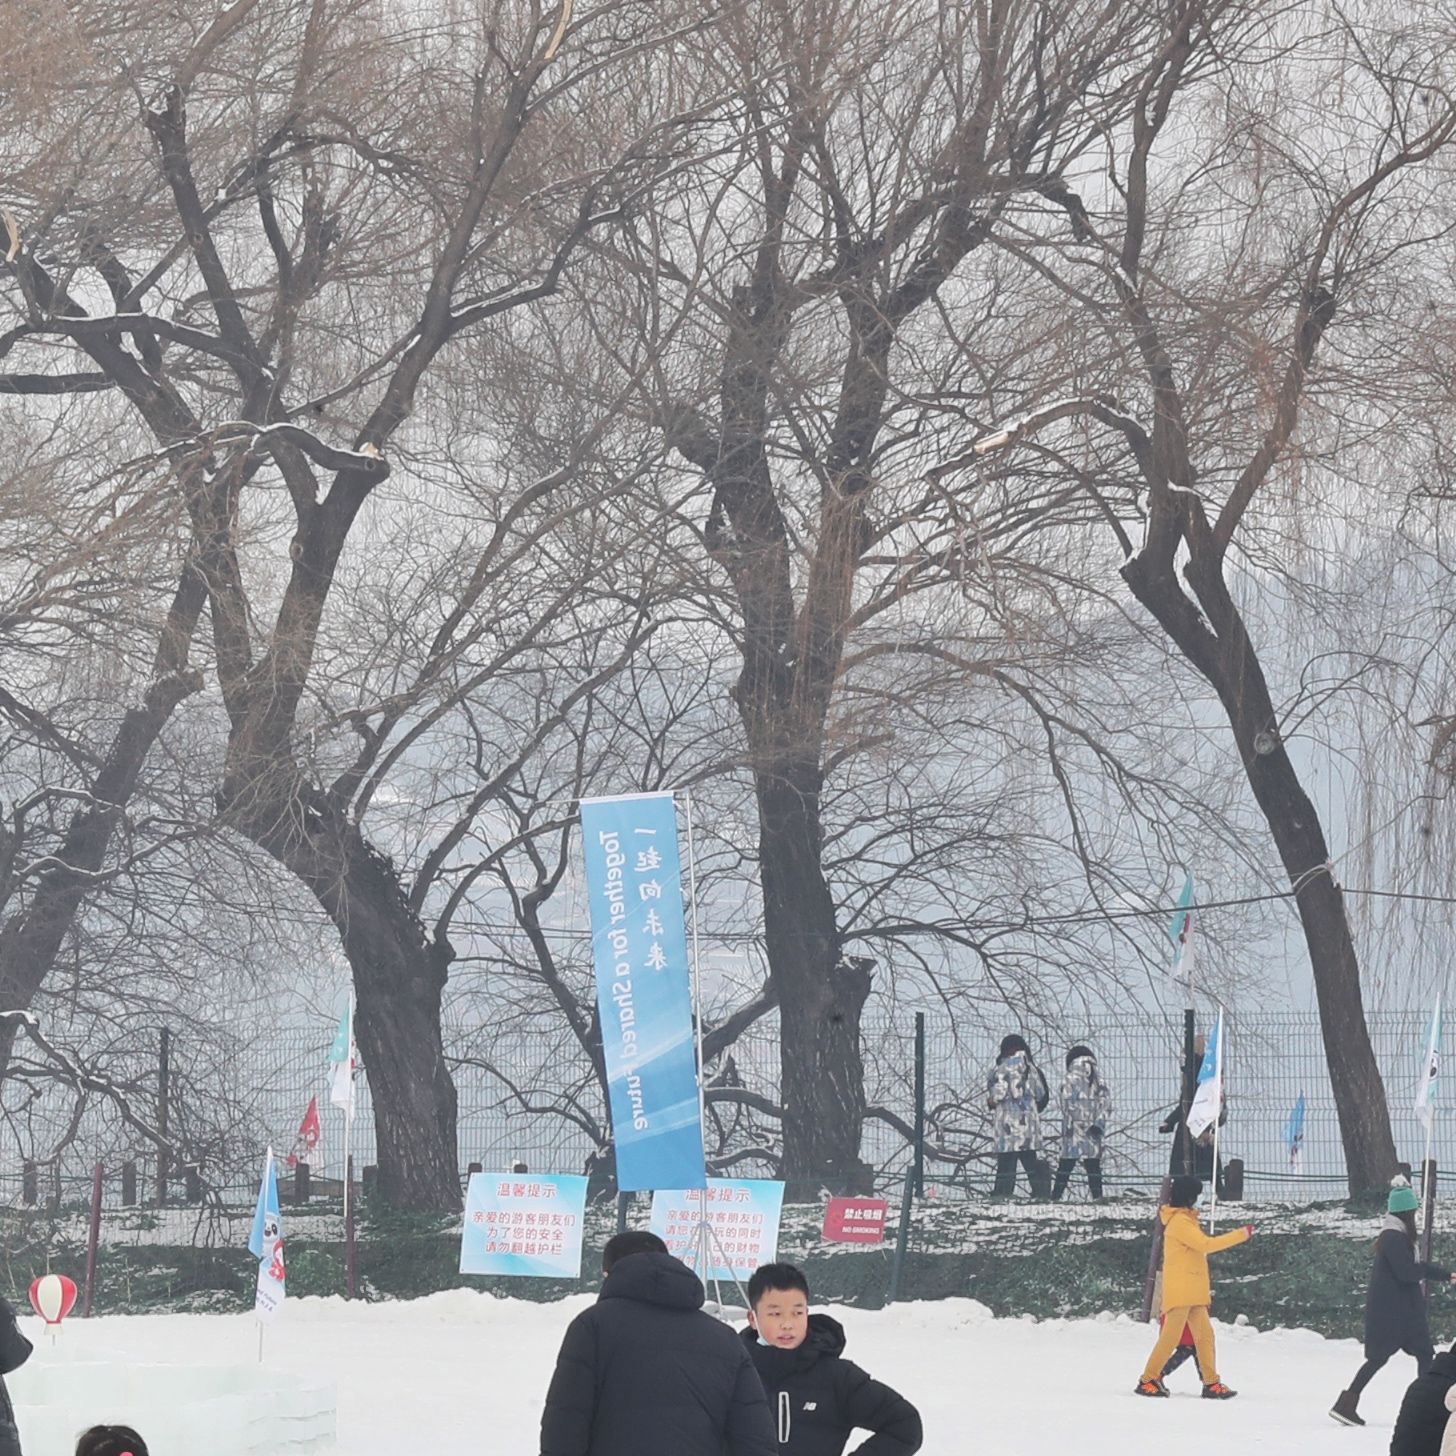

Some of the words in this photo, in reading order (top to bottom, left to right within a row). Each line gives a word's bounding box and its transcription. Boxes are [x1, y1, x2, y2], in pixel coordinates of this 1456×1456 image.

[497, 1183, 557, 1198] 温馨提示
[473, 1211, 576, 1226] 亲爱的游客朋友们
[844, 1208, 883, 1220] 禁止吸烟
[488, 1226, 564, 1241] 为了您的安全
[485, 1241, 562, 1255] 请勿翻越护栏
